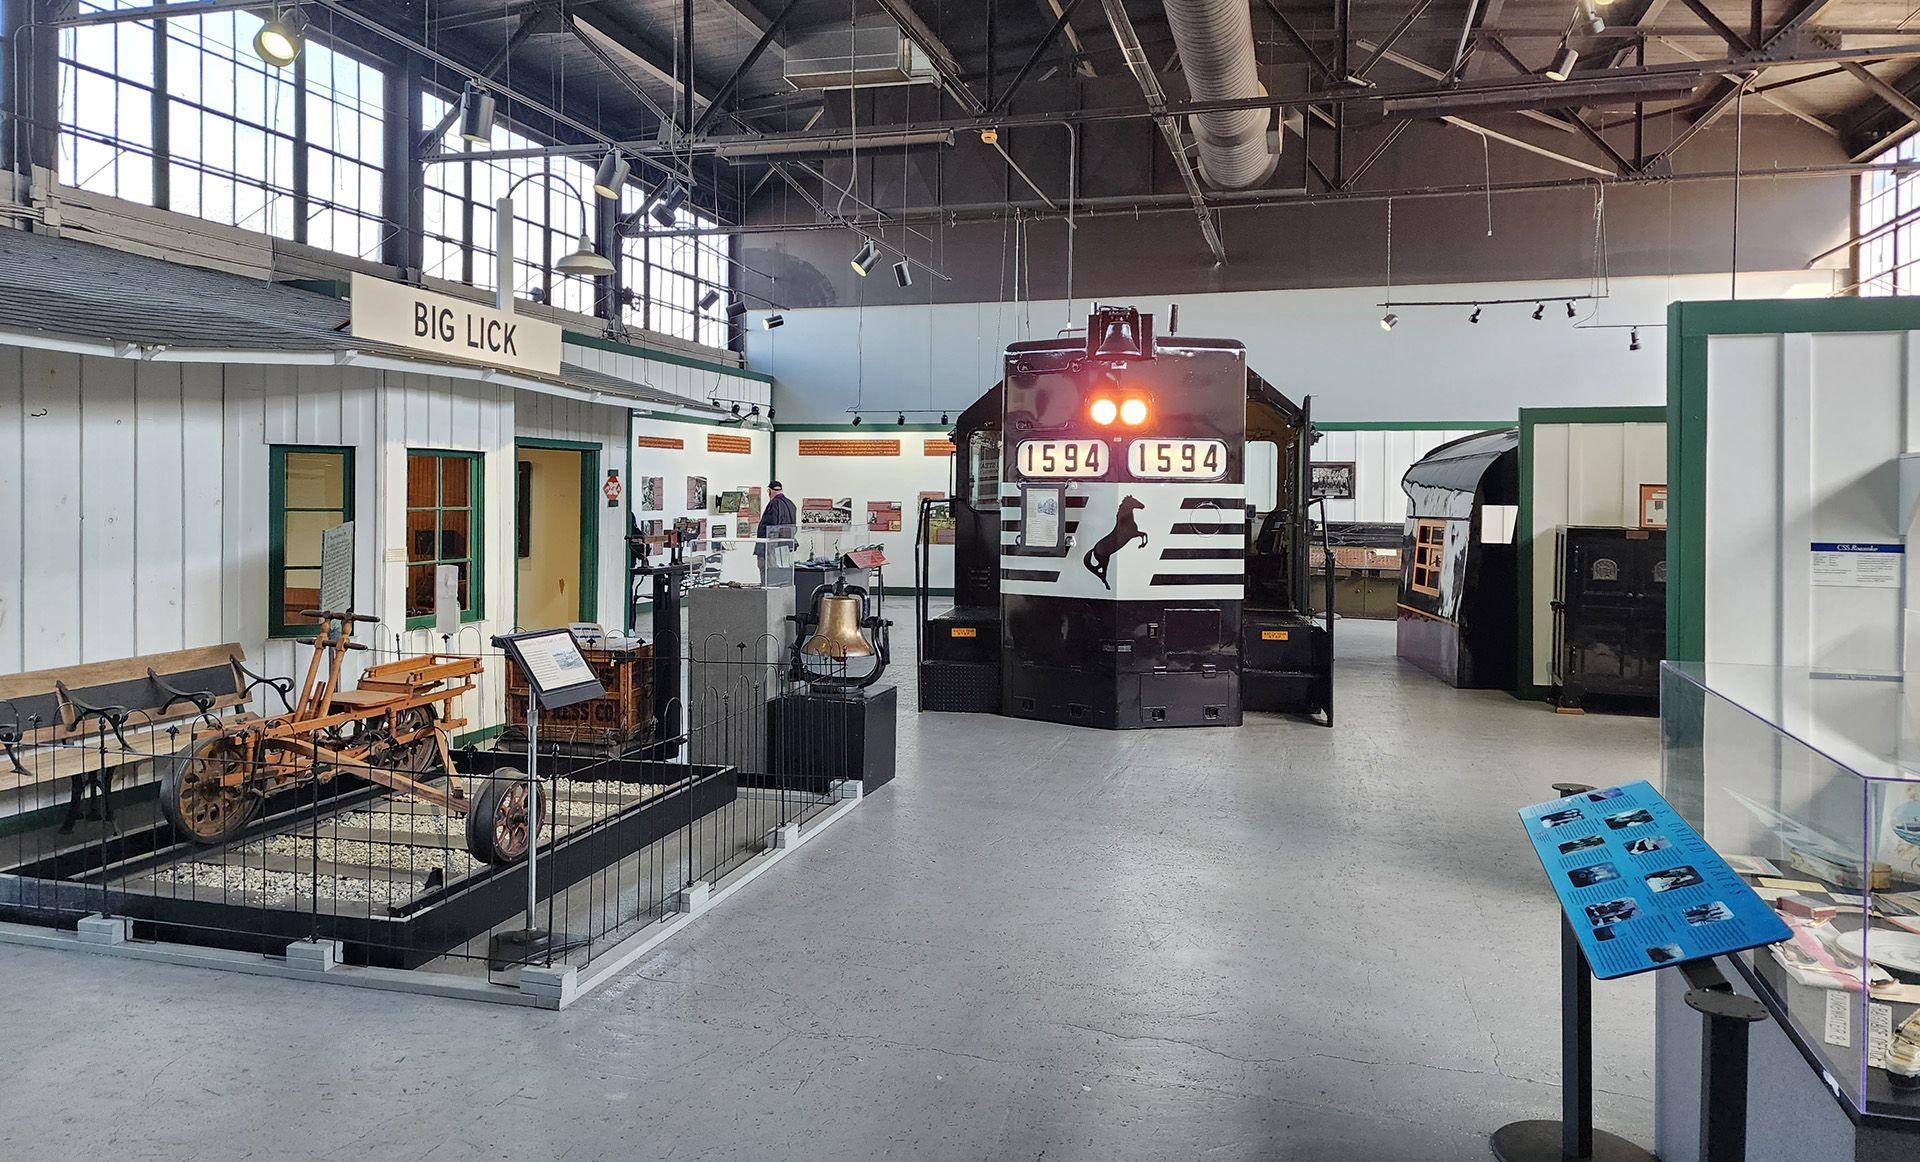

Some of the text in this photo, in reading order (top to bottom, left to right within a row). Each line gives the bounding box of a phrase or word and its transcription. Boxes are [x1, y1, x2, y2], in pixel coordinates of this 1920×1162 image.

[414, 300, 517, 356] BIG LICK
[1027, 443, 1100, 473] 1594
[1139, 443, 1218, 473] 1594
[1649, 801, 1671, 818] S.S.
[1667, 822, 1706, 853] UNITED
[1702, 860, 1748, 895] STATES
